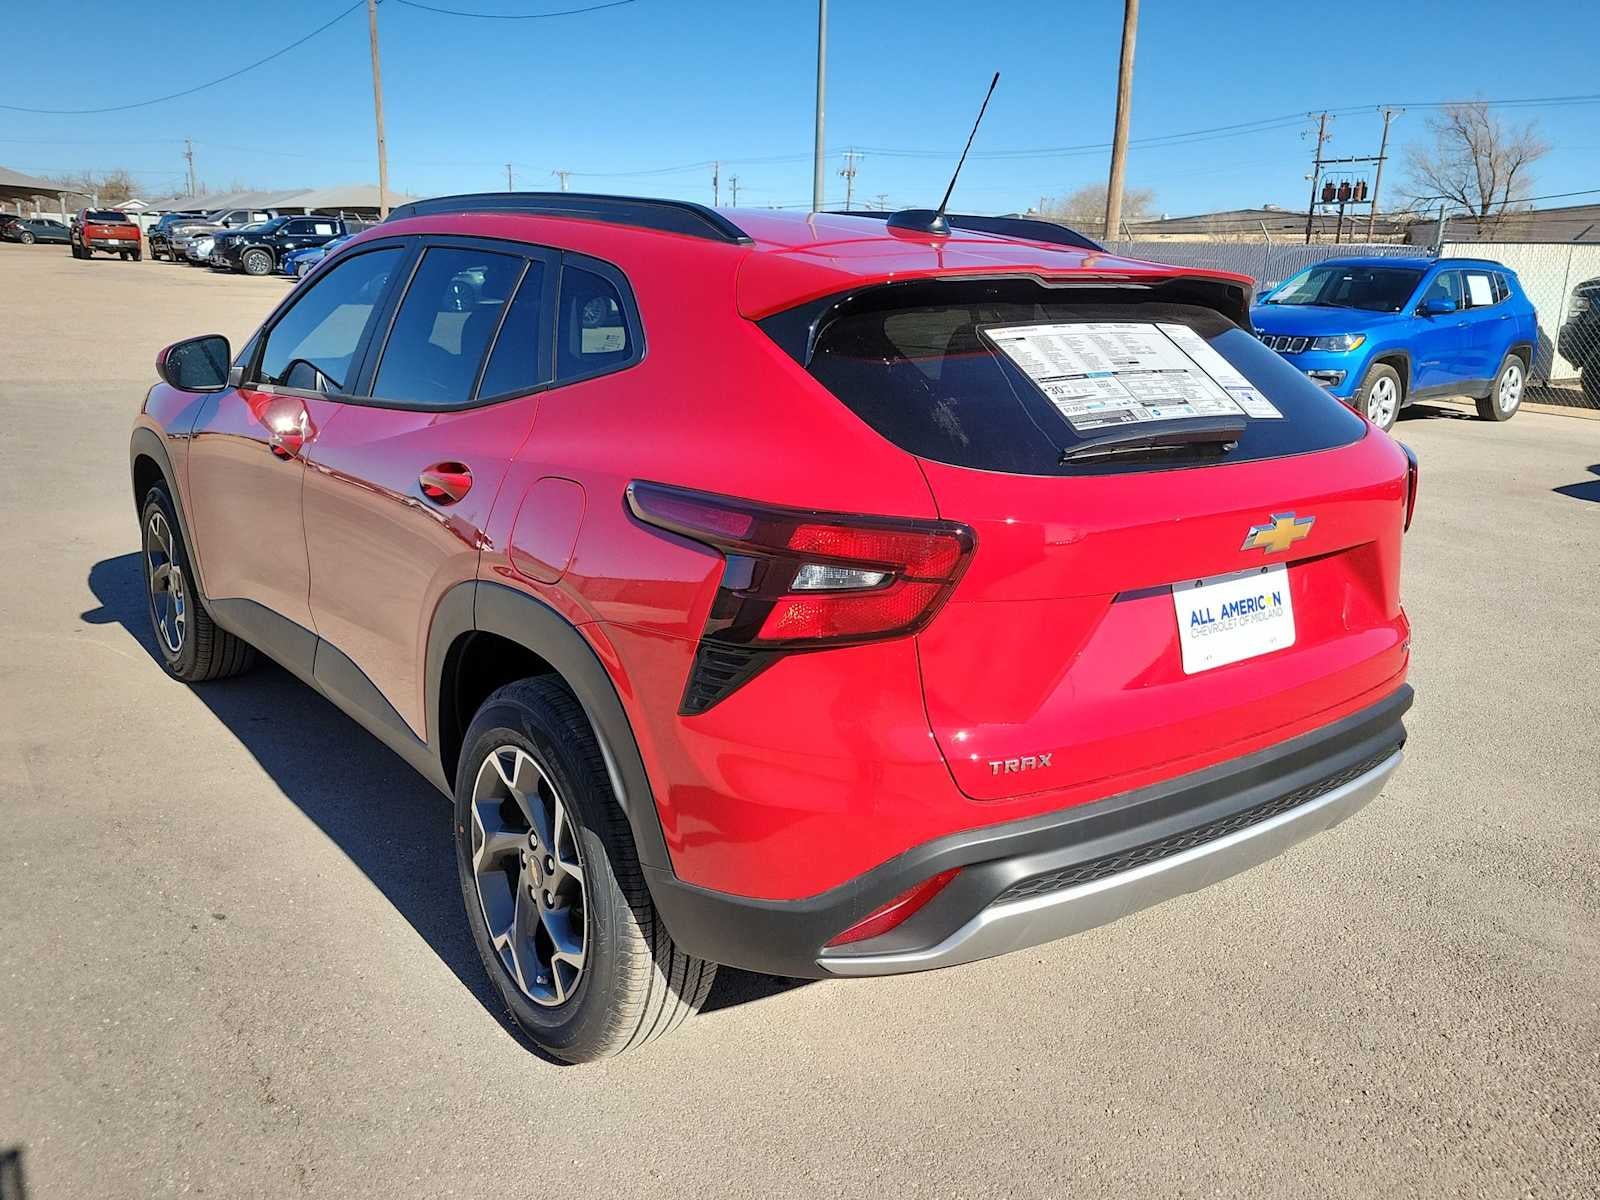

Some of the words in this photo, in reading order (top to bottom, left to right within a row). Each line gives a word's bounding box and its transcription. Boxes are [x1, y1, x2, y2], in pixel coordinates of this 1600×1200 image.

[1190, 607, 1215, 628] ALL
[1221, 591, 1282, 620] AMERICN
[1191, 617, 1238, 639] CHEVROLET
[1239, 615, 1250, 627] OF
[1250, 607, 1284, 624] MIDLAND
[989, 752, 1053, 776] TRAX
